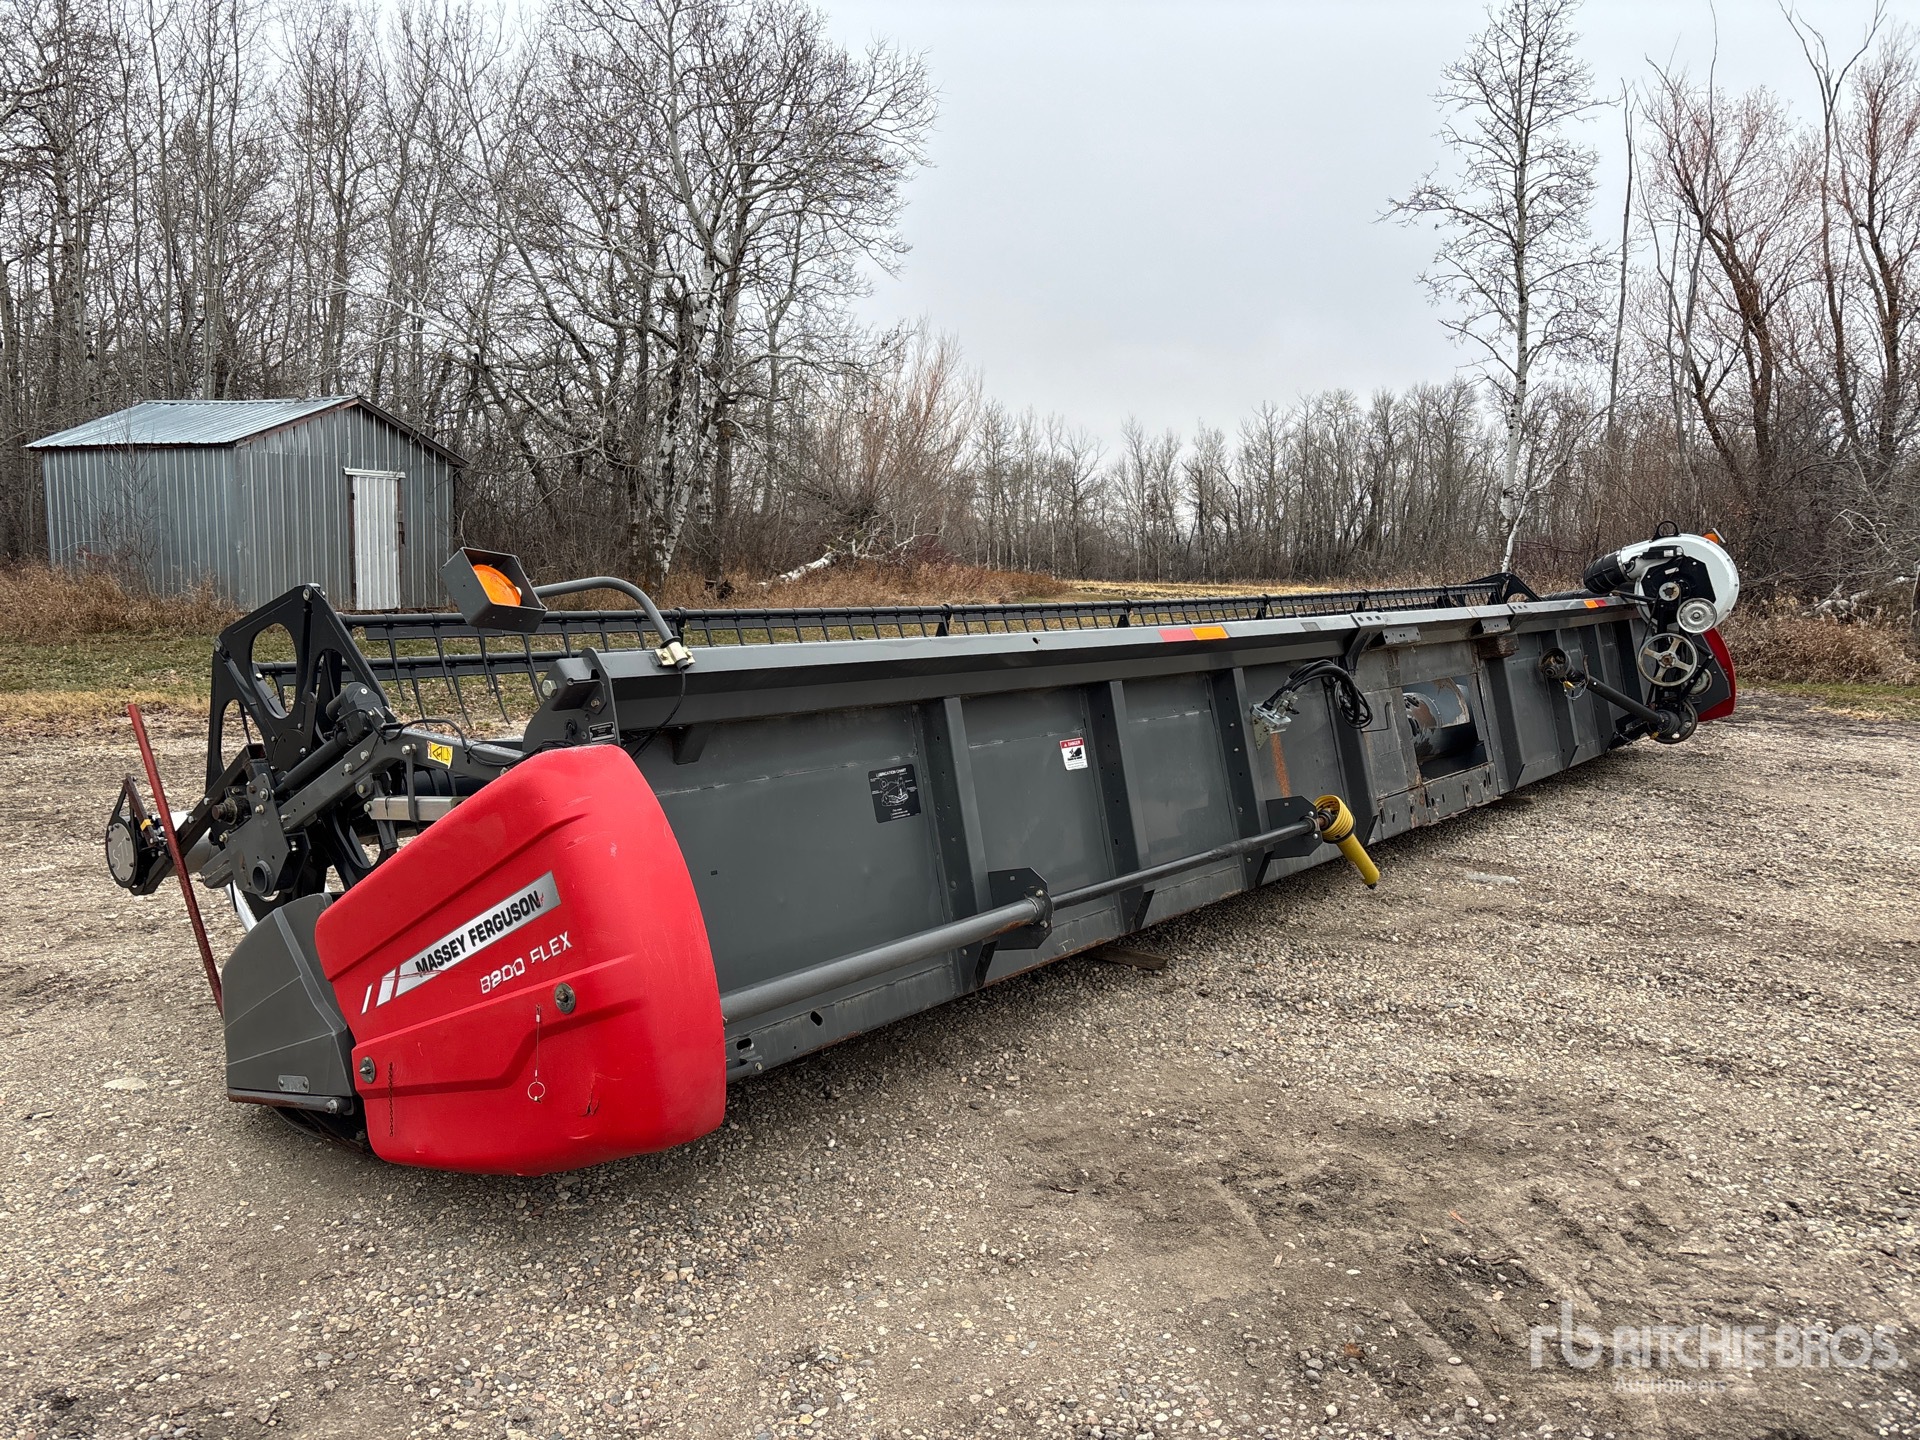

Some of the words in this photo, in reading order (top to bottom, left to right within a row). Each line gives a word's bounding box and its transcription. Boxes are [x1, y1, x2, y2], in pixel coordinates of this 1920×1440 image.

[415, 933, 467, 976] MASSEY
[468, 890, 542, 948] FERGUSON
[479, 957, 526, 995] 8200
[529, 931, 573, 964] FLEX
